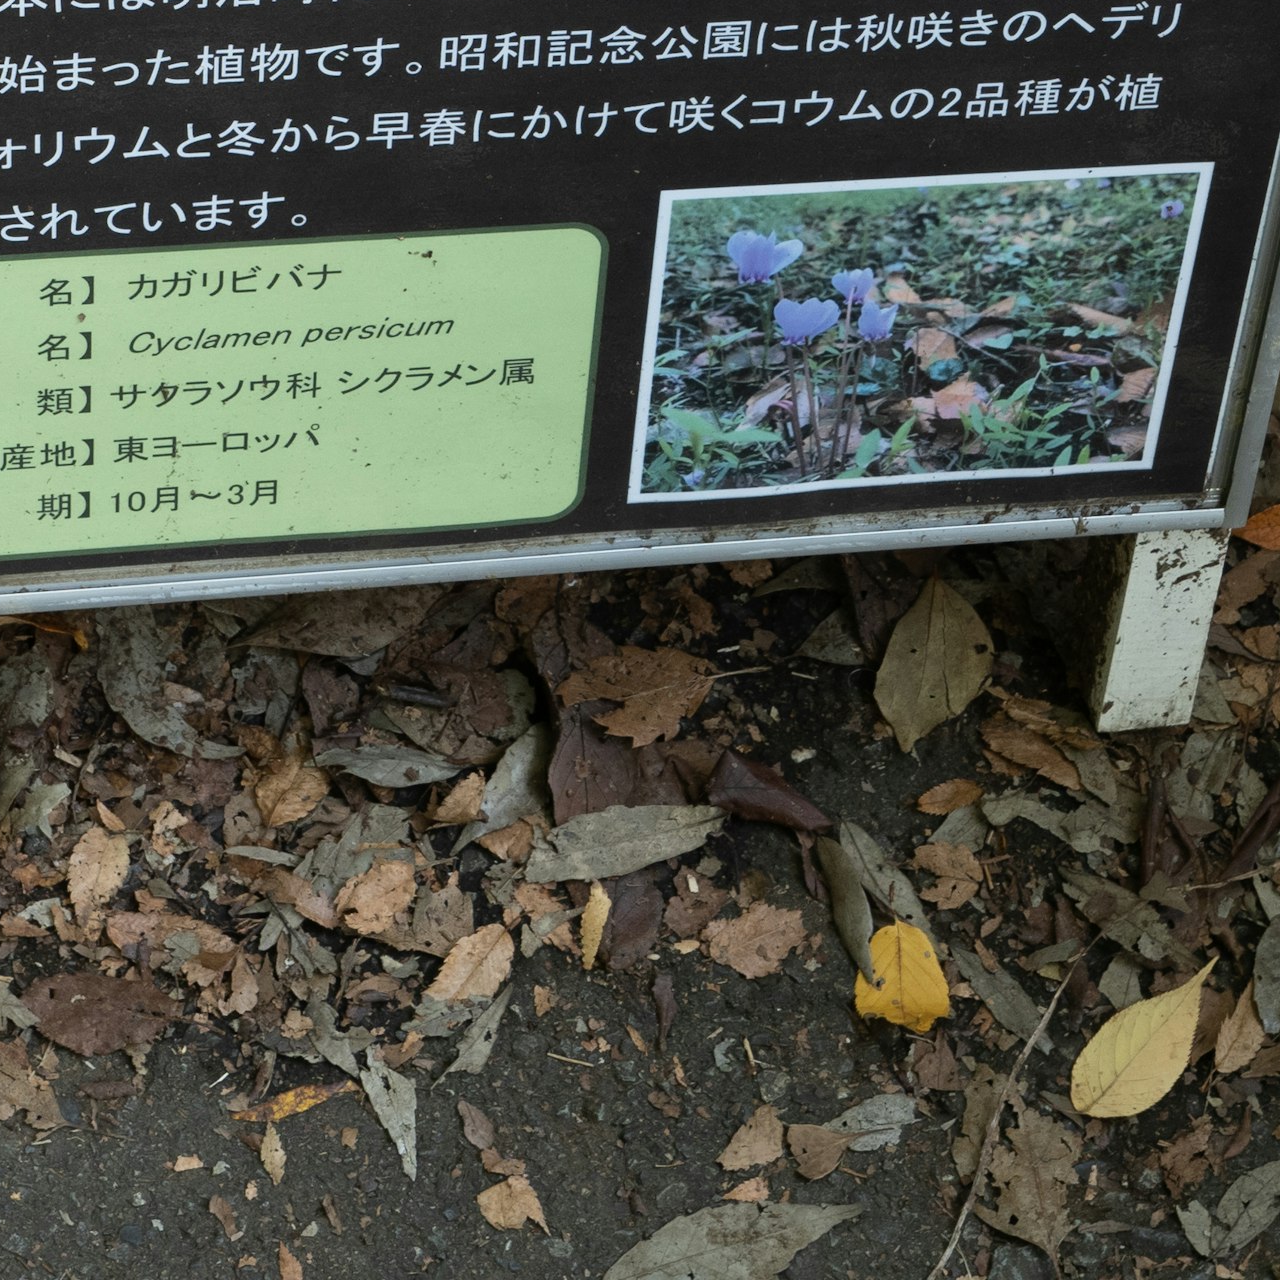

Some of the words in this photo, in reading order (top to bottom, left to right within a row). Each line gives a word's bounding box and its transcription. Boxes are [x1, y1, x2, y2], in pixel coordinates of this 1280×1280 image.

[127, 264, 343, 300] カガリビバナ
[128, 326, 292, 356] Cyclamen
[300, 316, 455, 348] persicum
[338, 357, 535, 395] シクラメン属
